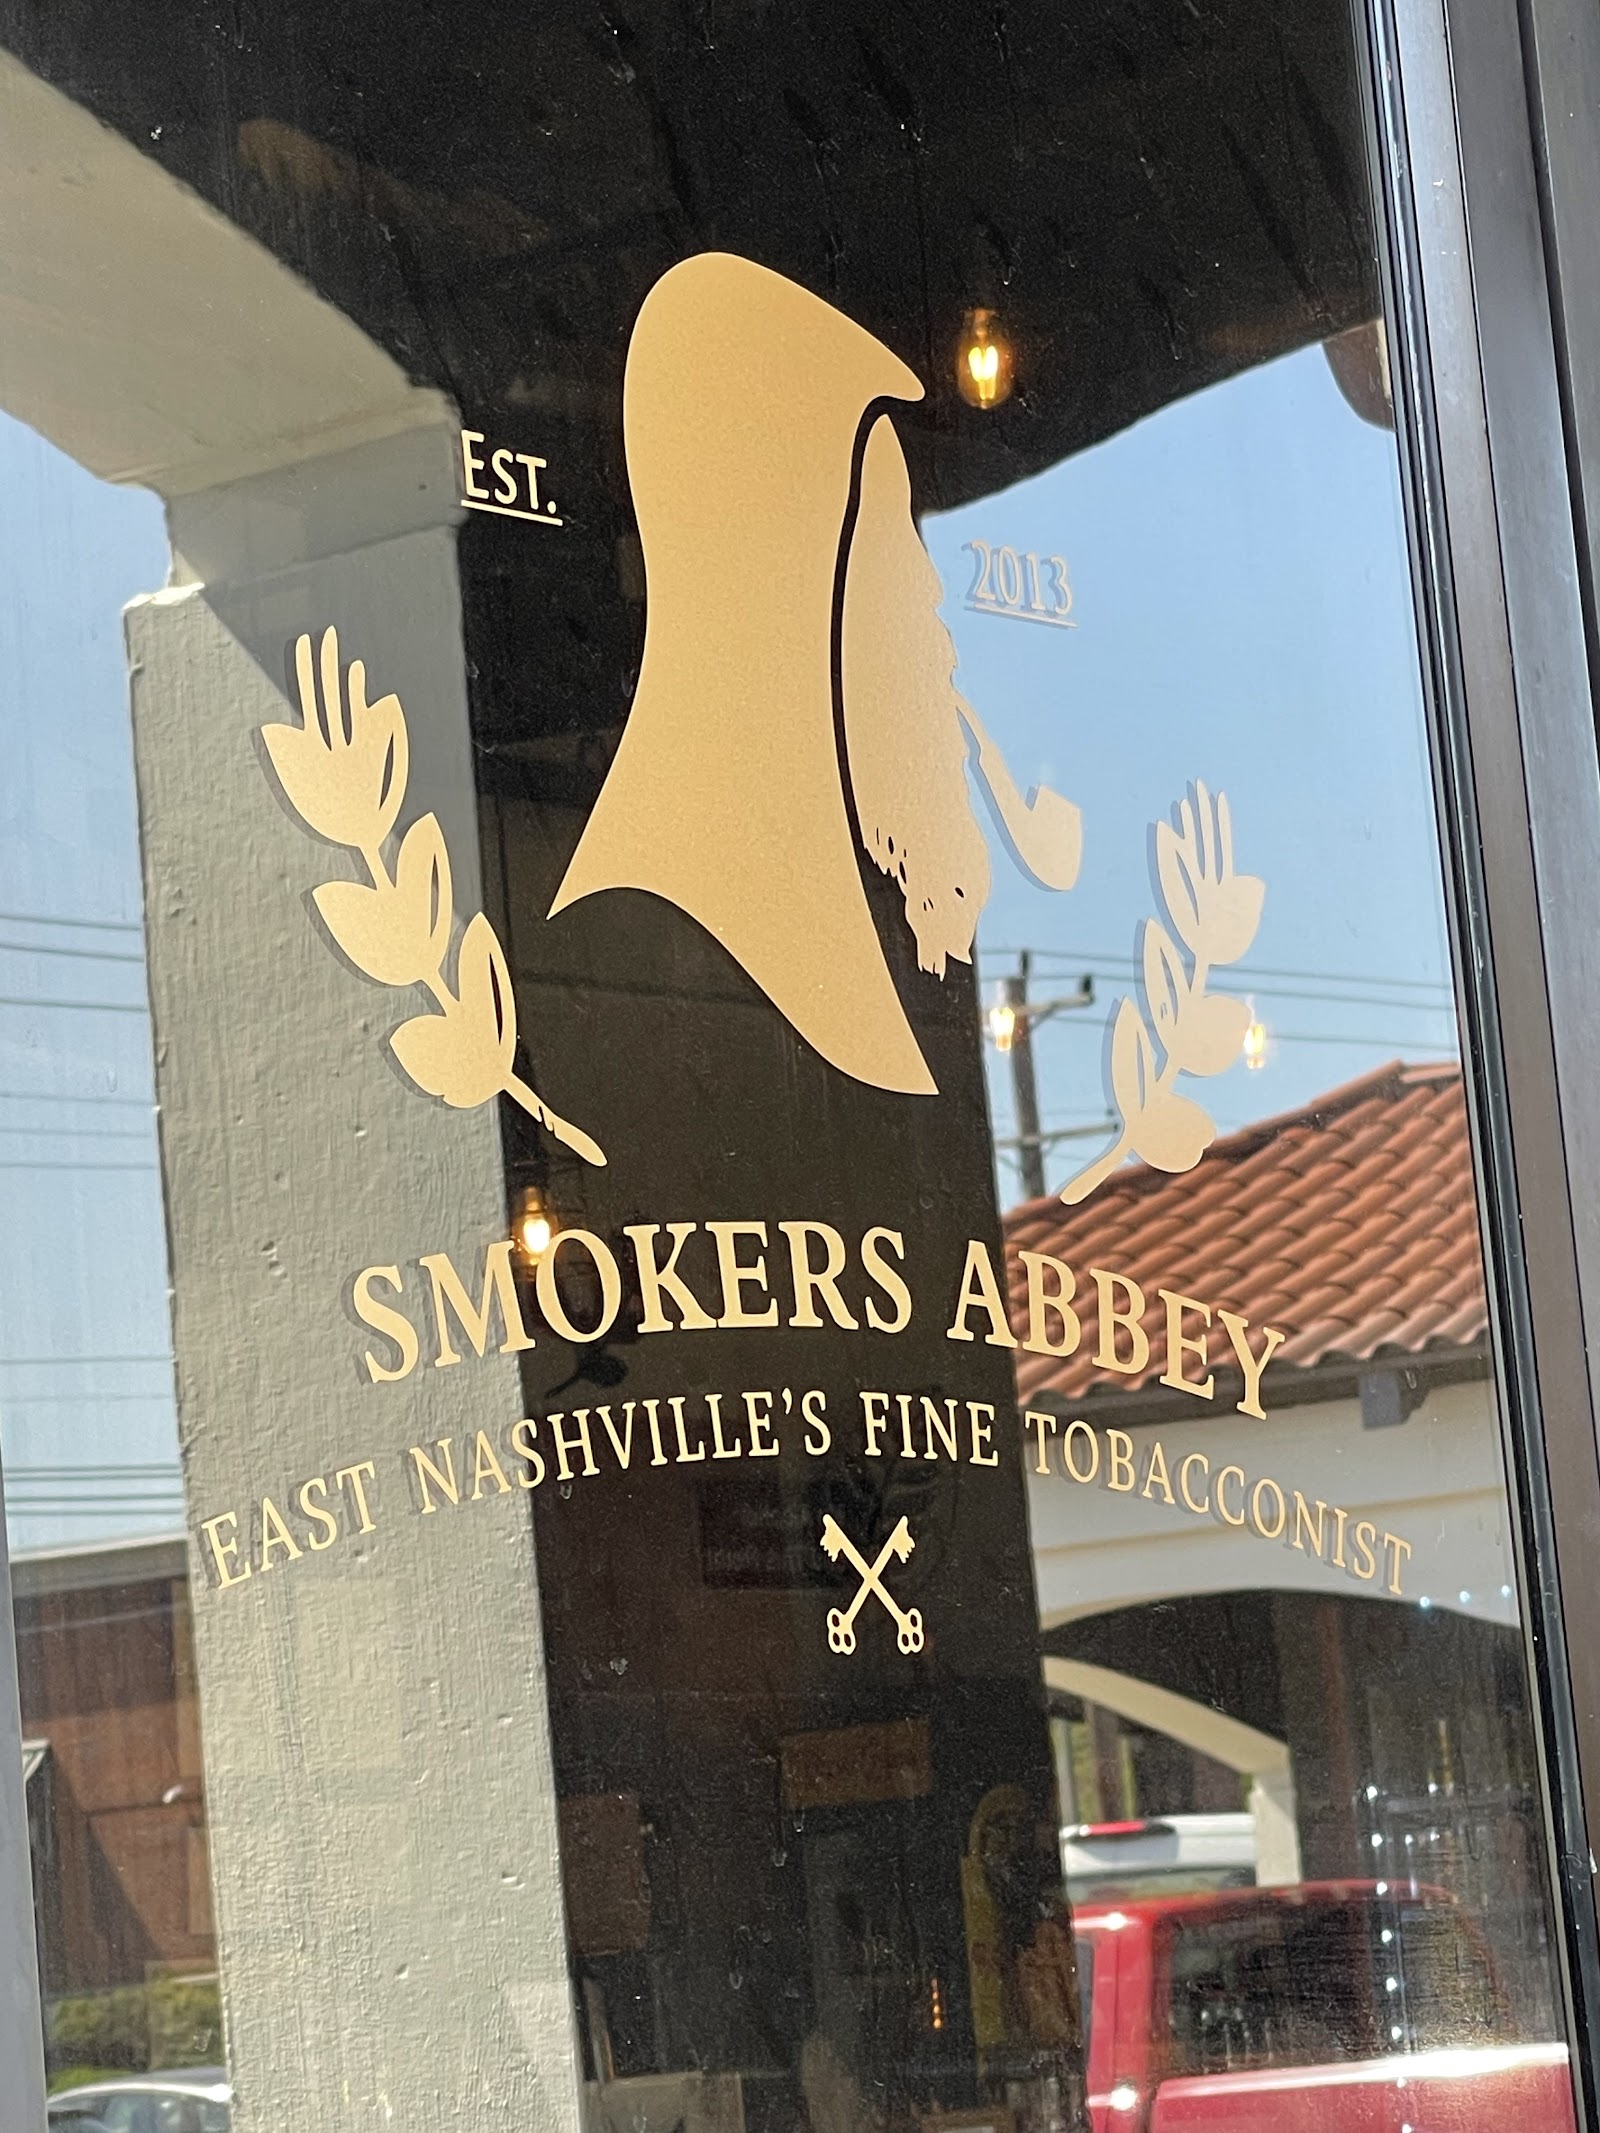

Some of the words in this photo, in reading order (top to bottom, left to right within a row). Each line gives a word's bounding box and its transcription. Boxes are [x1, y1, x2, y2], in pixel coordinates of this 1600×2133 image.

[461, 429, 557, 514] EST.
[970, 540, 1073, 615] 2013
[352, 1220, 912, 1383] SMOKERS
[946, 1239, 1285, 1420] ABBEY
[201, 1461, 376, 1590] EAST
[409, 1387, 832, 1515] NASHVILLE'S
[859, 1391, 999, 1467] FINE
[1025, 1410, 1412, 1596] TOBACCONIST
